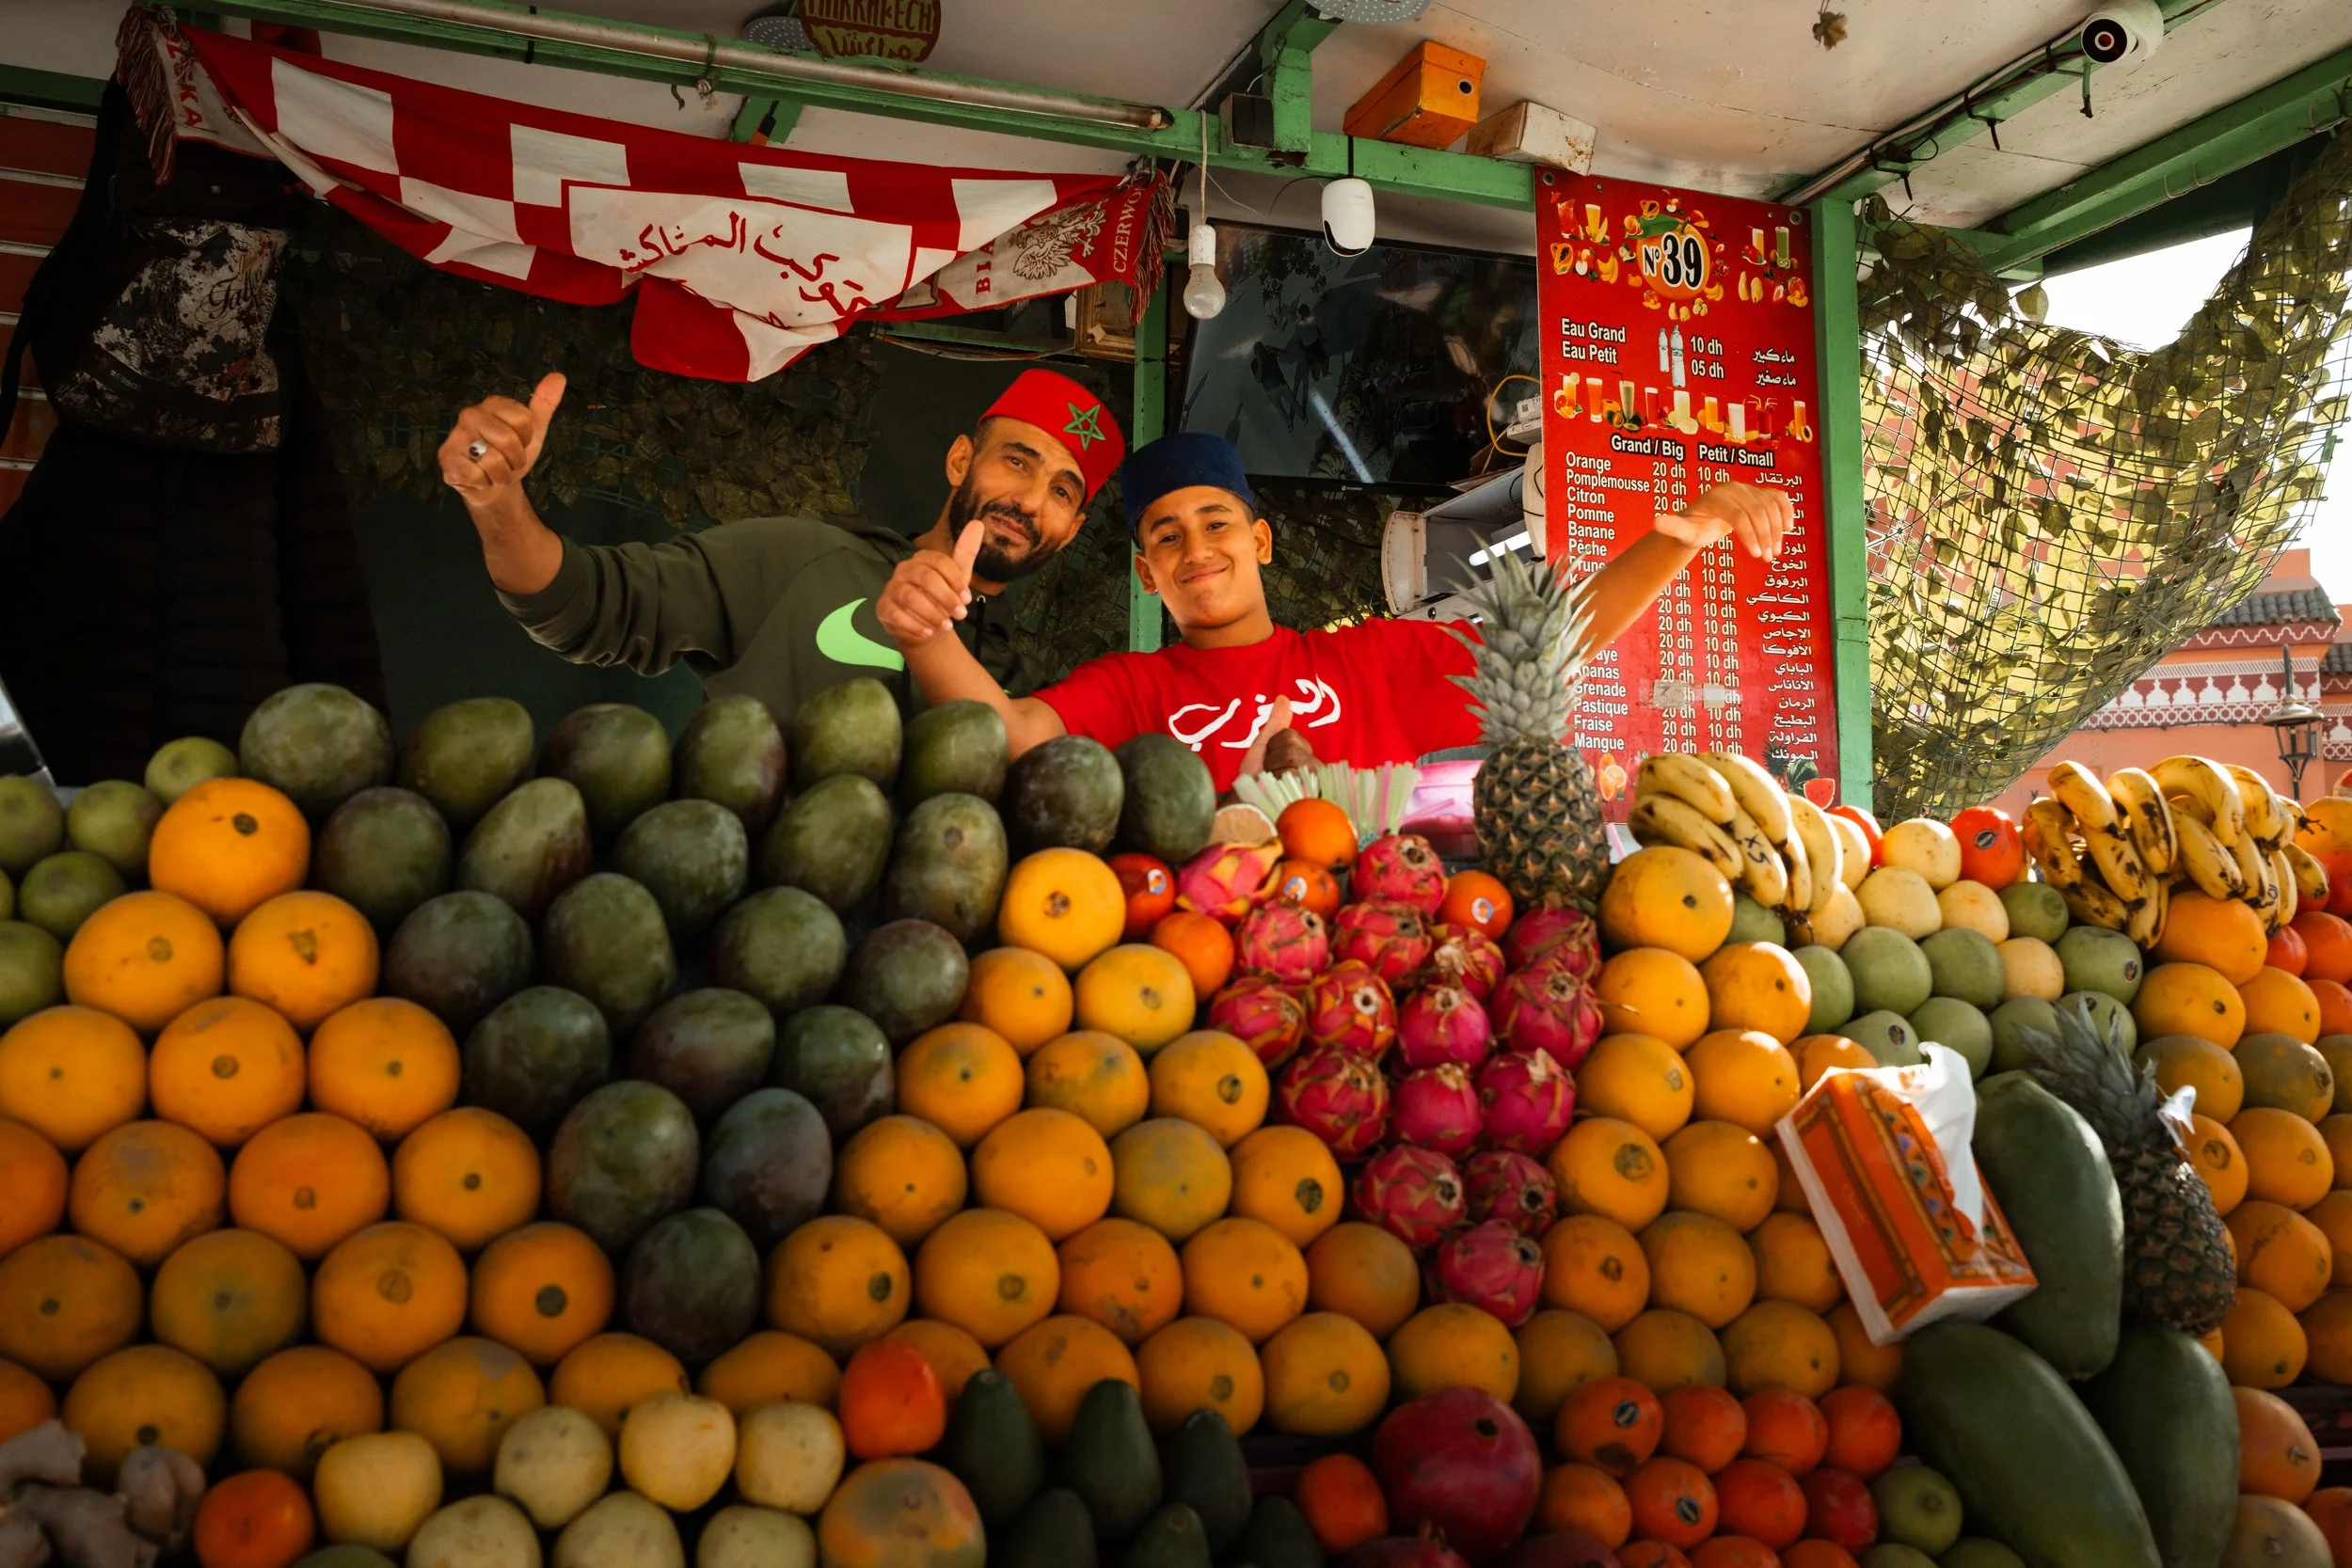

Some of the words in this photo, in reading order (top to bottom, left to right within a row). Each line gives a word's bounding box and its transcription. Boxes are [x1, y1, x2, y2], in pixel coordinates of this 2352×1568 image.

[1113, 187, 1146, 273] CZERWO
[1661, 232, 1704, 290] 39
[1562, 318, 1585, 338] Eau
[1588, 322, 1626, 343] Grand
[1562, 341, 1586, 360] Eau
[1590, 344, 1617, 364] Petit
[1691, 336, 1705, 354] 10
[1708, 339, 1723, 356] dh
[1752, 348, 1779, 364] كبير
[1691, 358, 1706, 376] 05
[1709, 361, 1724, 379] dh
[1756, 370, 1781, 386] صغير
[1612, 436, 1651, 454] Grand
[1661, 440, 1684, 461] Big
[1699, 445, 1728, 462] Petit
[1739, 449, 1773, 467] Small
[1565, 451, 1612, 474] Orange
[1653, 461, 1667, 477] 20
[1670, 464, 1686, 479] dh
[1566, 468, 1650, 493] Pomplemousse
[1697, 467, 1711, 482] 10
[1715, 468, 1730, 483] dh
[1756, 472, 1803, 487] البرتقال
[1567, 486, 1605, 505] Citron
[1653, 479, 1667, 494] 20
[1671, 481, 1687, 496] dh
[1654, 496, 1668, 511] 20
[1568, 503, 1615, 523] Pomme
[1568, 521, 1615, 541] Banane
[1718, 536, 1733, 551] dh
[1783, 542, 1806, 556] الموز
[1701, 551, 1715, 566] 10
[1718, 553, 1734, 567] dh
[1771, 557, 1807, 572] الخوخ
[1702, 568, 1716, 583] 10
[1719, 570, 1735, 585] dh
[1764, 574, 1808, 590] البرقوق
[1675, 583, 1691, 598] dh
[1702, 585, 1716, 600] 10
[1720, 587, 1736, 602] dh
[1746, 592, 1809, 605] الكاكي
[1658, 598, 1672, 614] 20
[1676, 600, 1692, 615] dh
[1703, 602, 1717, 617] 10
[1721, 604, 1737, 619] dh
[1658, 616, 1673, 631] 20
[1677, 617, 1692, 632] dh
[1757, 610, 1810, 623] الكيوي
[1704, 619, 1718, 634] 10
[1722, 621, 1738, 636] dh
[1659, 633, 1674, 648] 20
[1677, 635, 1693, 650] dh
[1705, 637, 1719, 652] 10
[1723, 638, 1739, 653] dh
[1660, 650, 1675, 666] 20
[1677, 652, 1693, 667] dh
[1706, 654, 1720, 669] 10
[1724, 655, 1740, 670] dh
[1661, 668, 1675, 683] 20
[1678, 669, 1694, 685] dh
[1774, 662, 1813, 675] الباباي
[1706, 671, 1721, 686] 10
[1724, 673, 1740, 688] dh
[1725, 689, 1740, 705] dh
[1778, 696, 1815, 711] الرمان
[1573, 696, 1629, 718] Pastique
[1680, 705, 1696, 720] dh
[1725, 707, 1741, 722] dh
[1574, 714, 1613, 732] Fraise
[1662, 721, 1677, 736] 20
[1680, 721, 1696, 736] dh
[1773, 713, 1816, 729] البطيخ
[1708, 723, 1723, 738] 10
[1726, 724, 1742, 739] dh
[1769, 730, 1818, 745] الفراولة
[1574, 732, 1625, 753] Mangue
[1663, 738, 1677, 753] 20
[1681, 739, 1697, 754] dh
[1709, 740, 1724, 753] 10
[1727, 741, 1742, 756] dh
